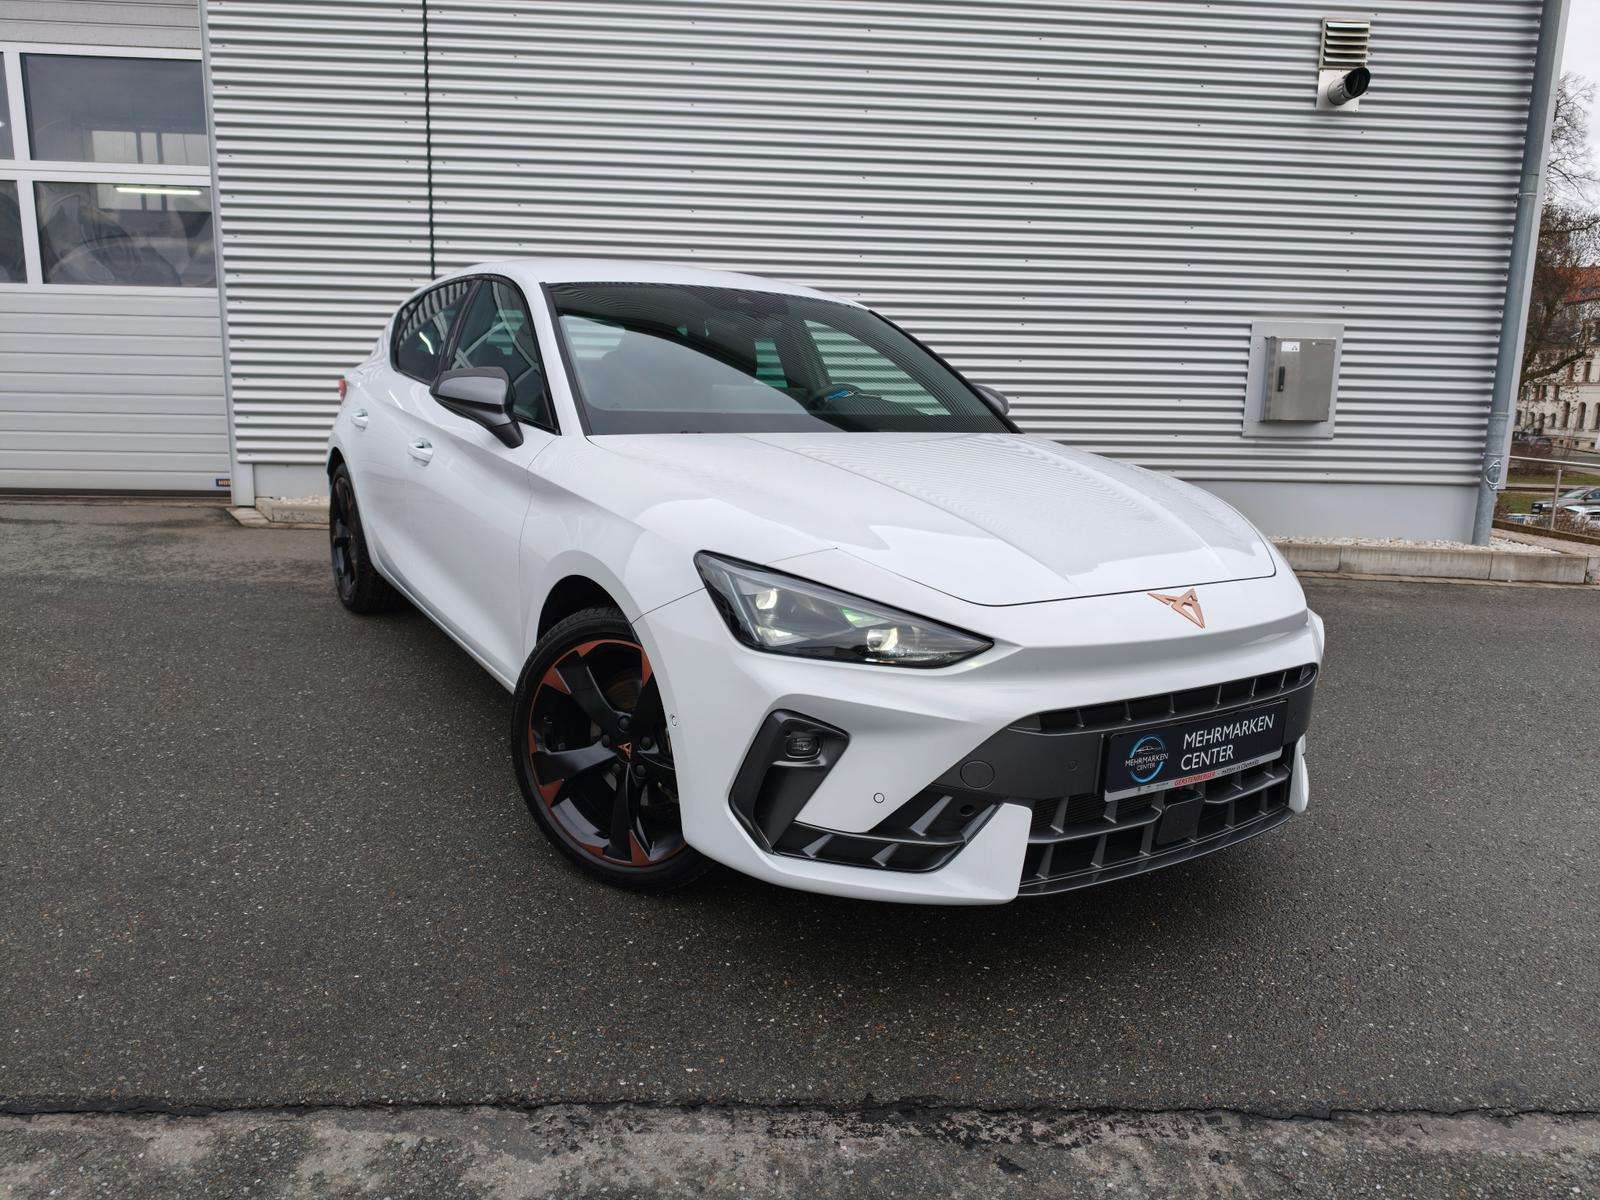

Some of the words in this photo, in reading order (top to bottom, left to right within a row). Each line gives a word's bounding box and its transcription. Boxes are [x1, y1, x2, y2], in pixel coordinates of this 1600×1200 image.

[1183, 713, 1275, 749] MEHRMARKEN
[1124, 753, 1169, 768] MEHRMARKEN
[1136, 762, 1156, 771] CENTER
[1181, 744, 1234, 771] CENTER
